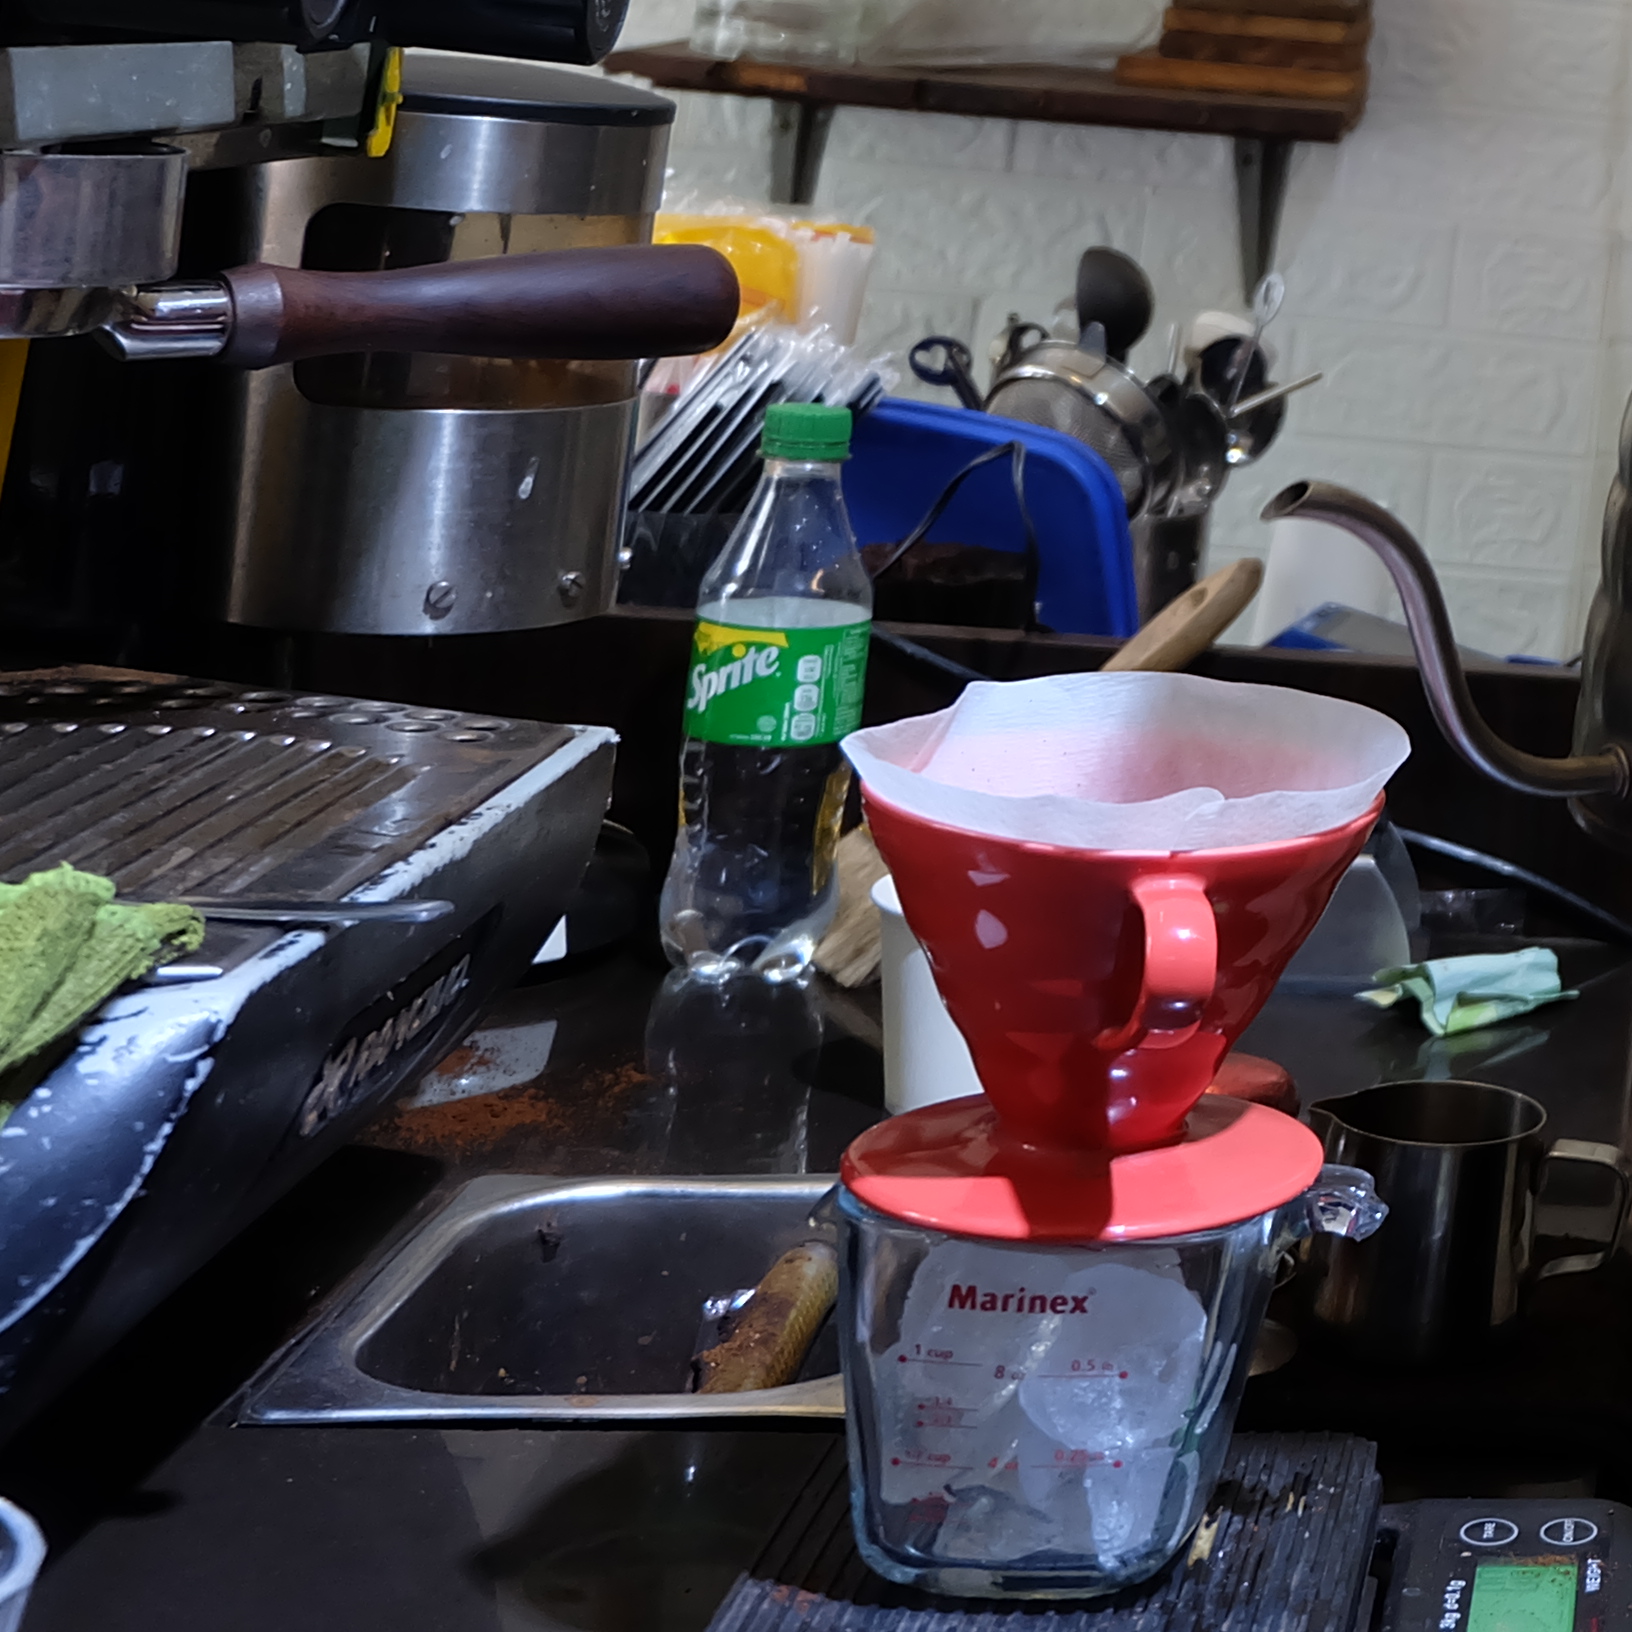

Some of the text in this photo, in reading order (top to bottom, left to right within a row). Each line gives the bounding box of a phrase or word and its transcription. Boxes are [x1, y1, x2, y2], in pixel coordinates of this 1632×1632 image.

[687, 643, 780, 714] Sprite
[948, 1284, 1089, 1314] Marinex
[927, 1349, 953, 1360] cup
[994, 1365, 1005, 1379] 8
[1071, 1359, 1096, 1372] 0.5
[1482, 1522, 1496, 1539] TARE
[1585, 1558, 1602, 1594] WEIGHT
